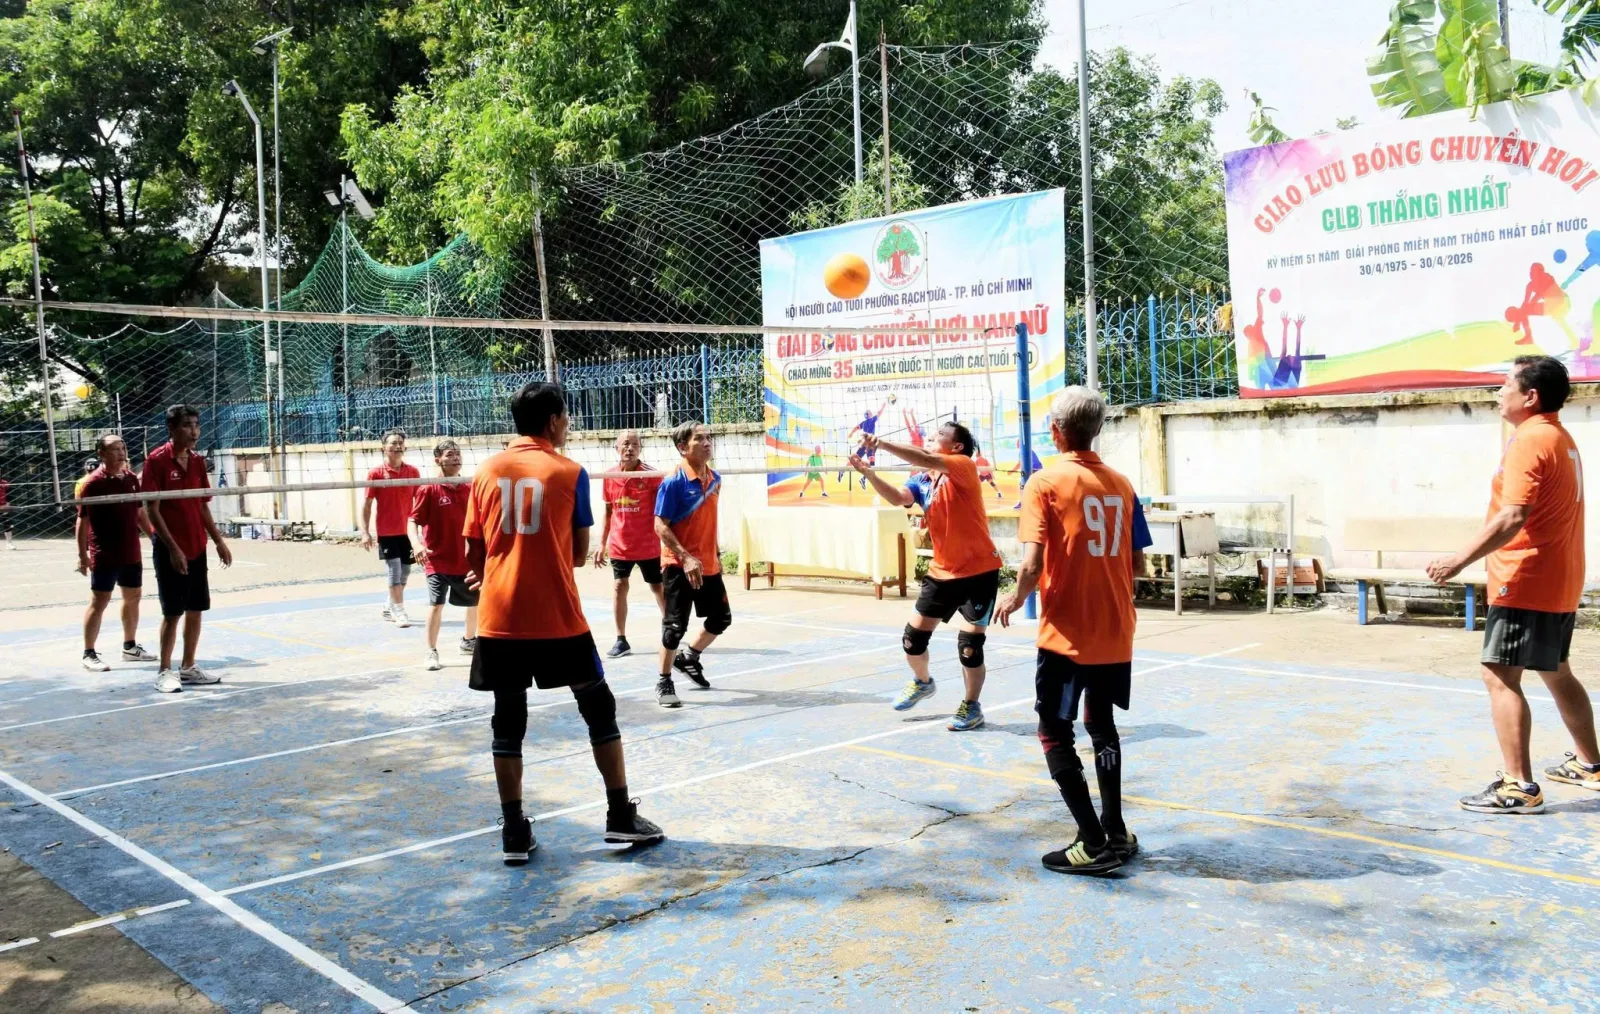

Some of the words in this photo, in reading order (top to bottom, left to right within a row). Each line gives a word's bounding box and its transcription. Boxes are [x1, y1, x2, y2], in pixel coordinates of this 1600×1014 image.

[1254, 185, 1302, 233] GIAO
[1304, 159, 1346, 196] LƯU
[1352, 139, 1421, 177] BÓNG
[1430, 127, 1539, 168] CHUYỀN
[1538, 147, 1600, 192] HƠI
[1322, 204, 1361, 232] CLB
[1367, 188, 1441, 226] THẮNG
[1448, 175, 1510, 215] NHẤT
[1306, 253, 1316, 265] 51
[1433, 235, 1457, 248] NAM
[1499, 223, 1527, 240] NHẤT
[1531, 219, 1552, 236] ĐẤT
[1556, 217, 1588, 233] NƯỚC
[1359, 260, 1407, 275] 30/4/1975
[1420, 252, 1473, 269] 30/4/2026
[785, 304, 798, 320] HỘI
[799, 300, 825, 317] NGƯỜI
[826, 302, 843, 313] CAO
[865, 293, 899, 309] PHƯỜNG
[901, 291, 926, 307] RẠCH
[955, 286, 968, 299] TP.
[987, 277, 1004, 295] CHÍ
[1006, 277, 1033, 293] MINH
[834, 360, 853, 379] 35
[497, 477, 544, 534] 10
[1083, 495, 1124, 557] 97
